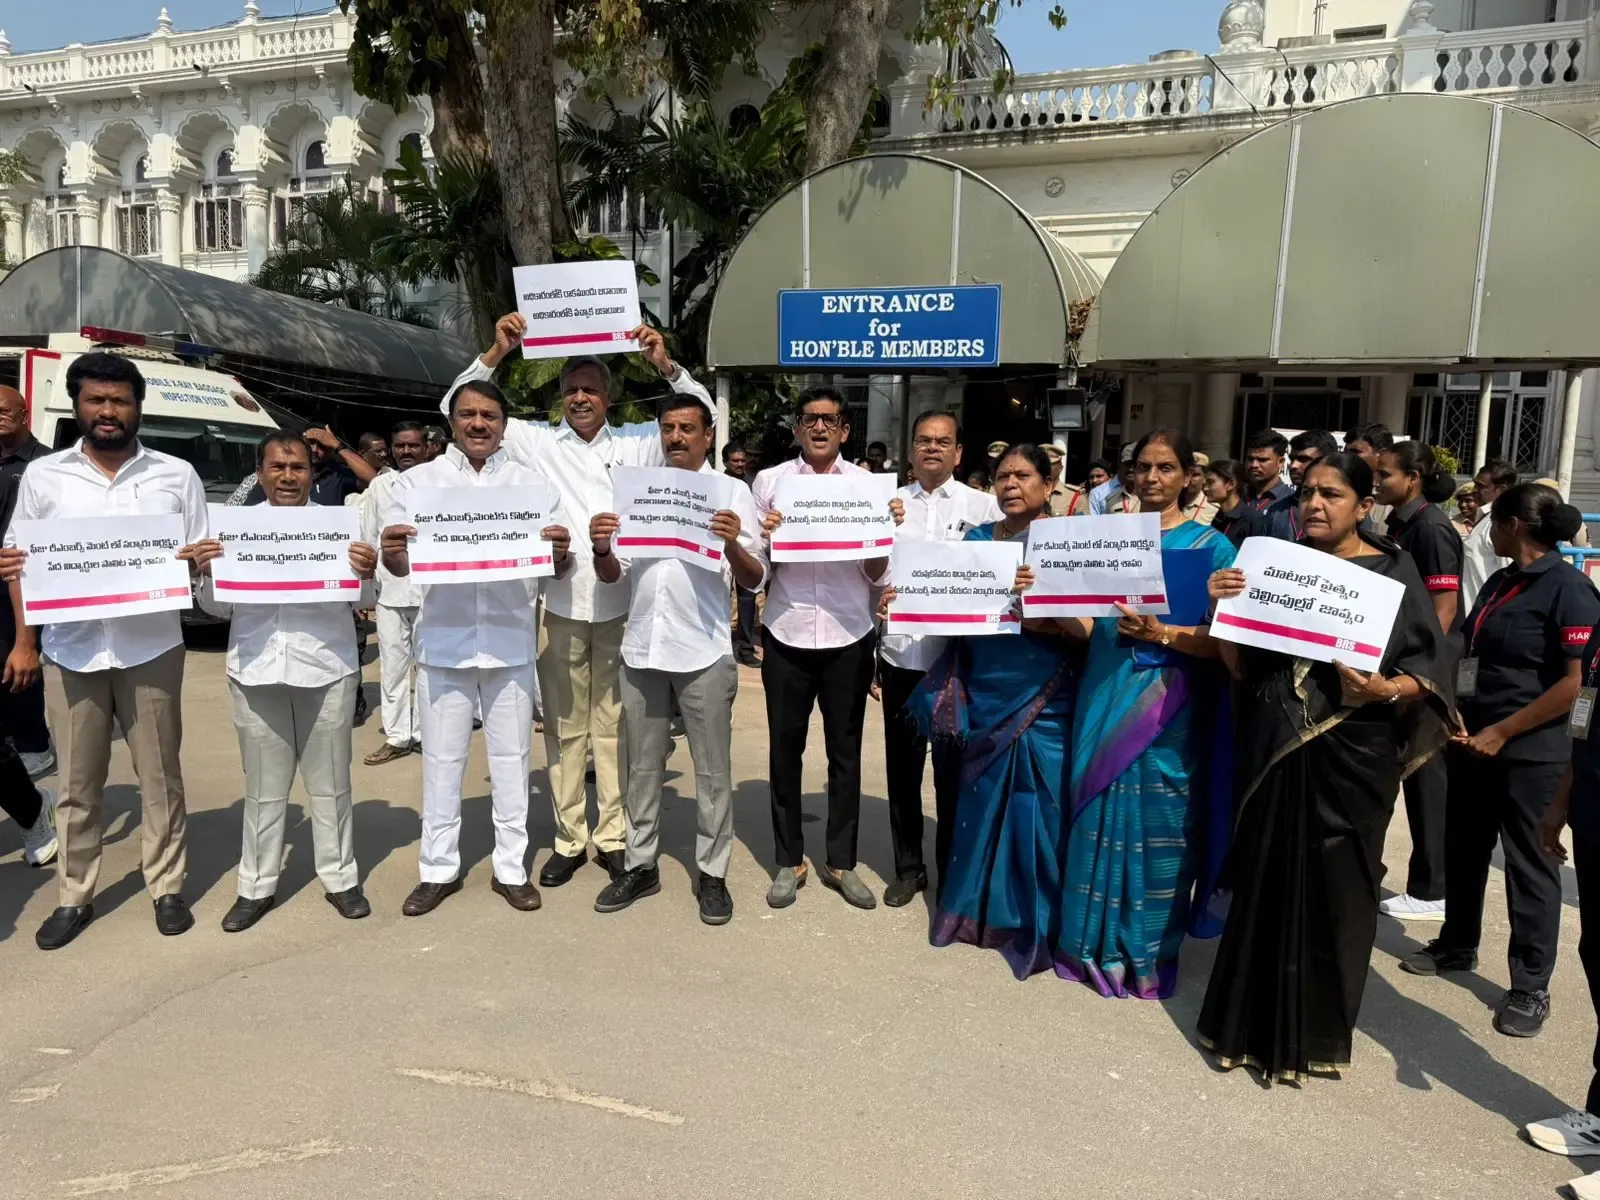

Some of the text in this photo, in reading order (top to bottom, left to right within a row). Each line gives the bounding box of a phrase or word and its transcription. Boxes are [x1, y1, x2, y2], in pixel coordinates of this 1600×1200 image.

[822, 293, 955, 314] ENTRANCE
[868, 318, 901, 337] for
[790, 339, 984, 358] HON'BLE MEMBERS
[170, 380, 193, 390] X-RAY
[192, 382, 228, 395] BAGGAGE
[160, 391, 229, 407] INSPECTION SYSTEM
[110, 539, 122, 550] లో
[862, 540, 876, 548] BRS
[1092, 539, 1103, 549] లో
[517, 557, 532, 566] BRS
[1263, 565, 1321, 588] మాటల్లో
[324, 580, 341, 589] BRS
[149, 589, 167, 600] BRS
[1126, 595, 1144, 604] BRS
[986, 614, 1001, 623] BRS
[1318, 604, 1365, 625] జాప్యం
[1335, 637, 1356, 651] BRS
